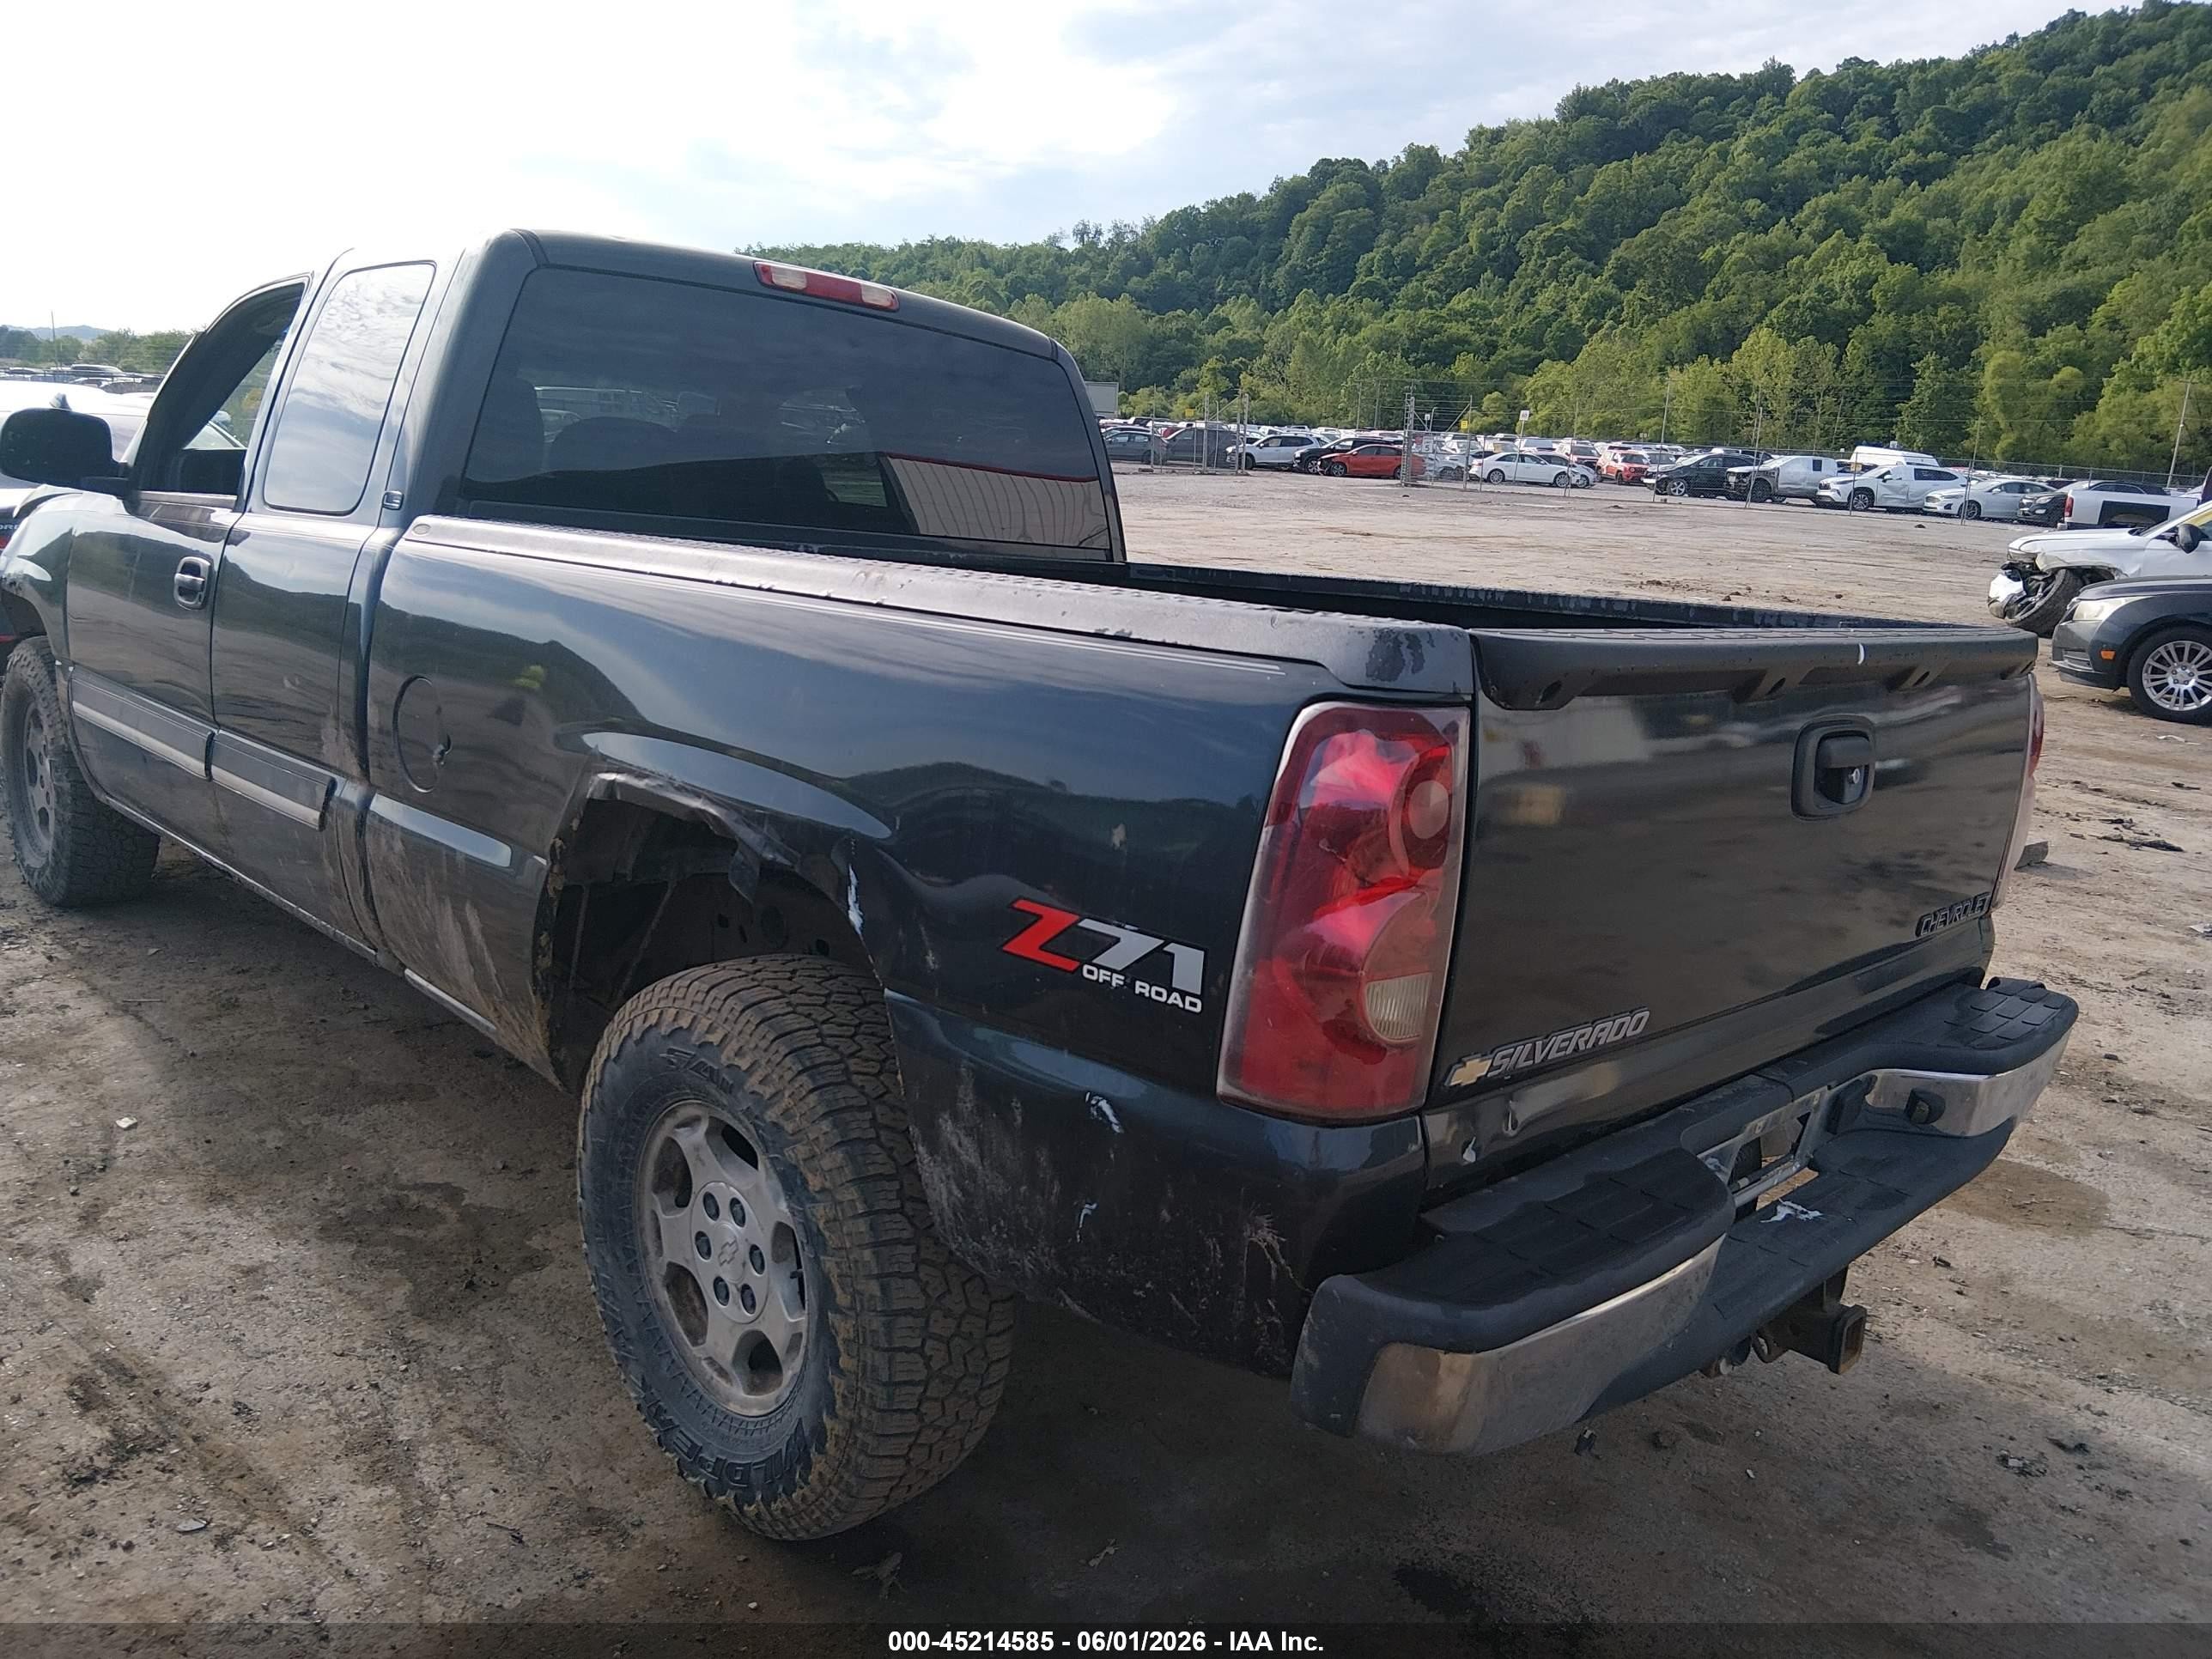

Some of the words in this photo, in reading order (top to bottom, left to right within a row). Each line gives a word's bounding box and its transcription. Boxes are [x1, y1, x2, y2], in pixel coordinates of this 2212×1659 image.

[1920, 893, 1991, 937] CHEVROLET
[1002, 898, 1205, 995] Z71
[1082, 964, 1125, 988] OFF
[1134, 981, 1202, 1014] ROAD
[1486, 1008, 1650, 1078] SILVERADO
